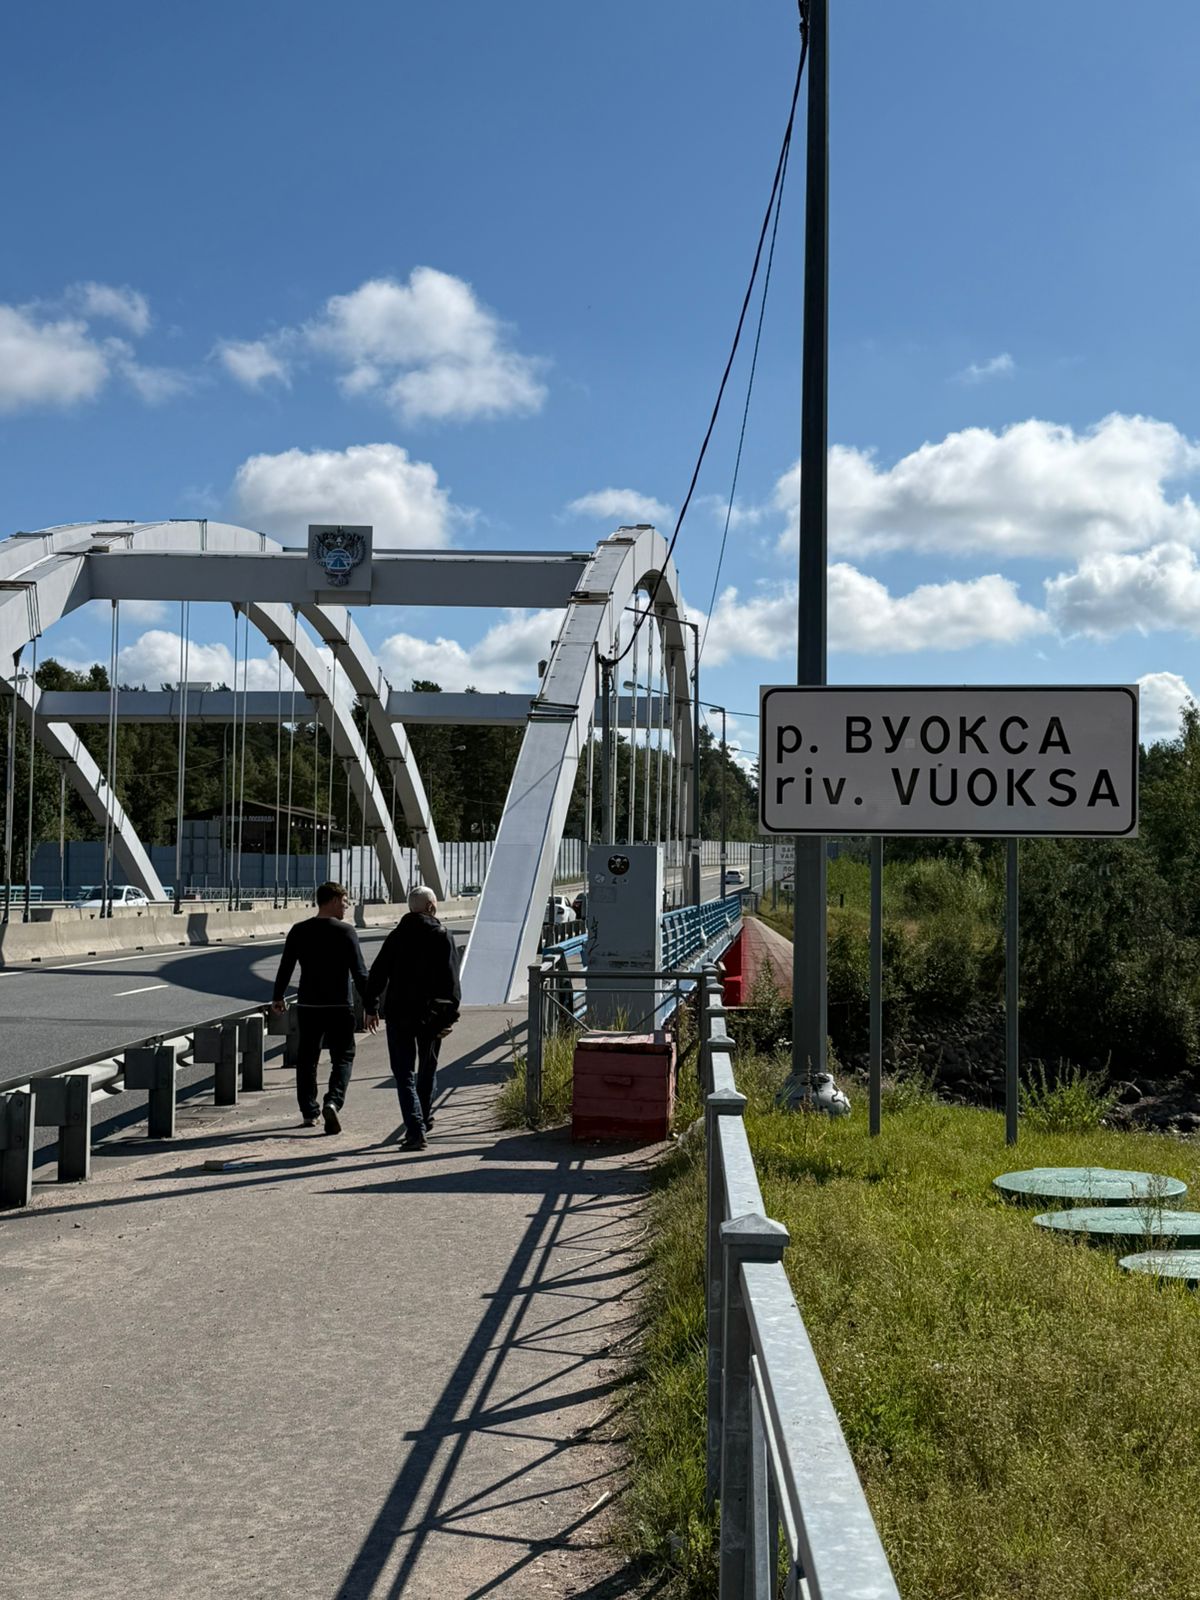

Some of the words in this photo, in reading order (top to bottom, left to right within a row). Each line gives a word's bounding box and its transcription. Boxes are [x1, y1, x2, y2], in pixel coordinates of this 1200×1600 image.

[777, 725, 818, 763] р.
[846, 716, 1071, 754] ВУОКСА
[777, 767, 862, 805] riv.
[891, 766, 1119, 807] VUOKSA
